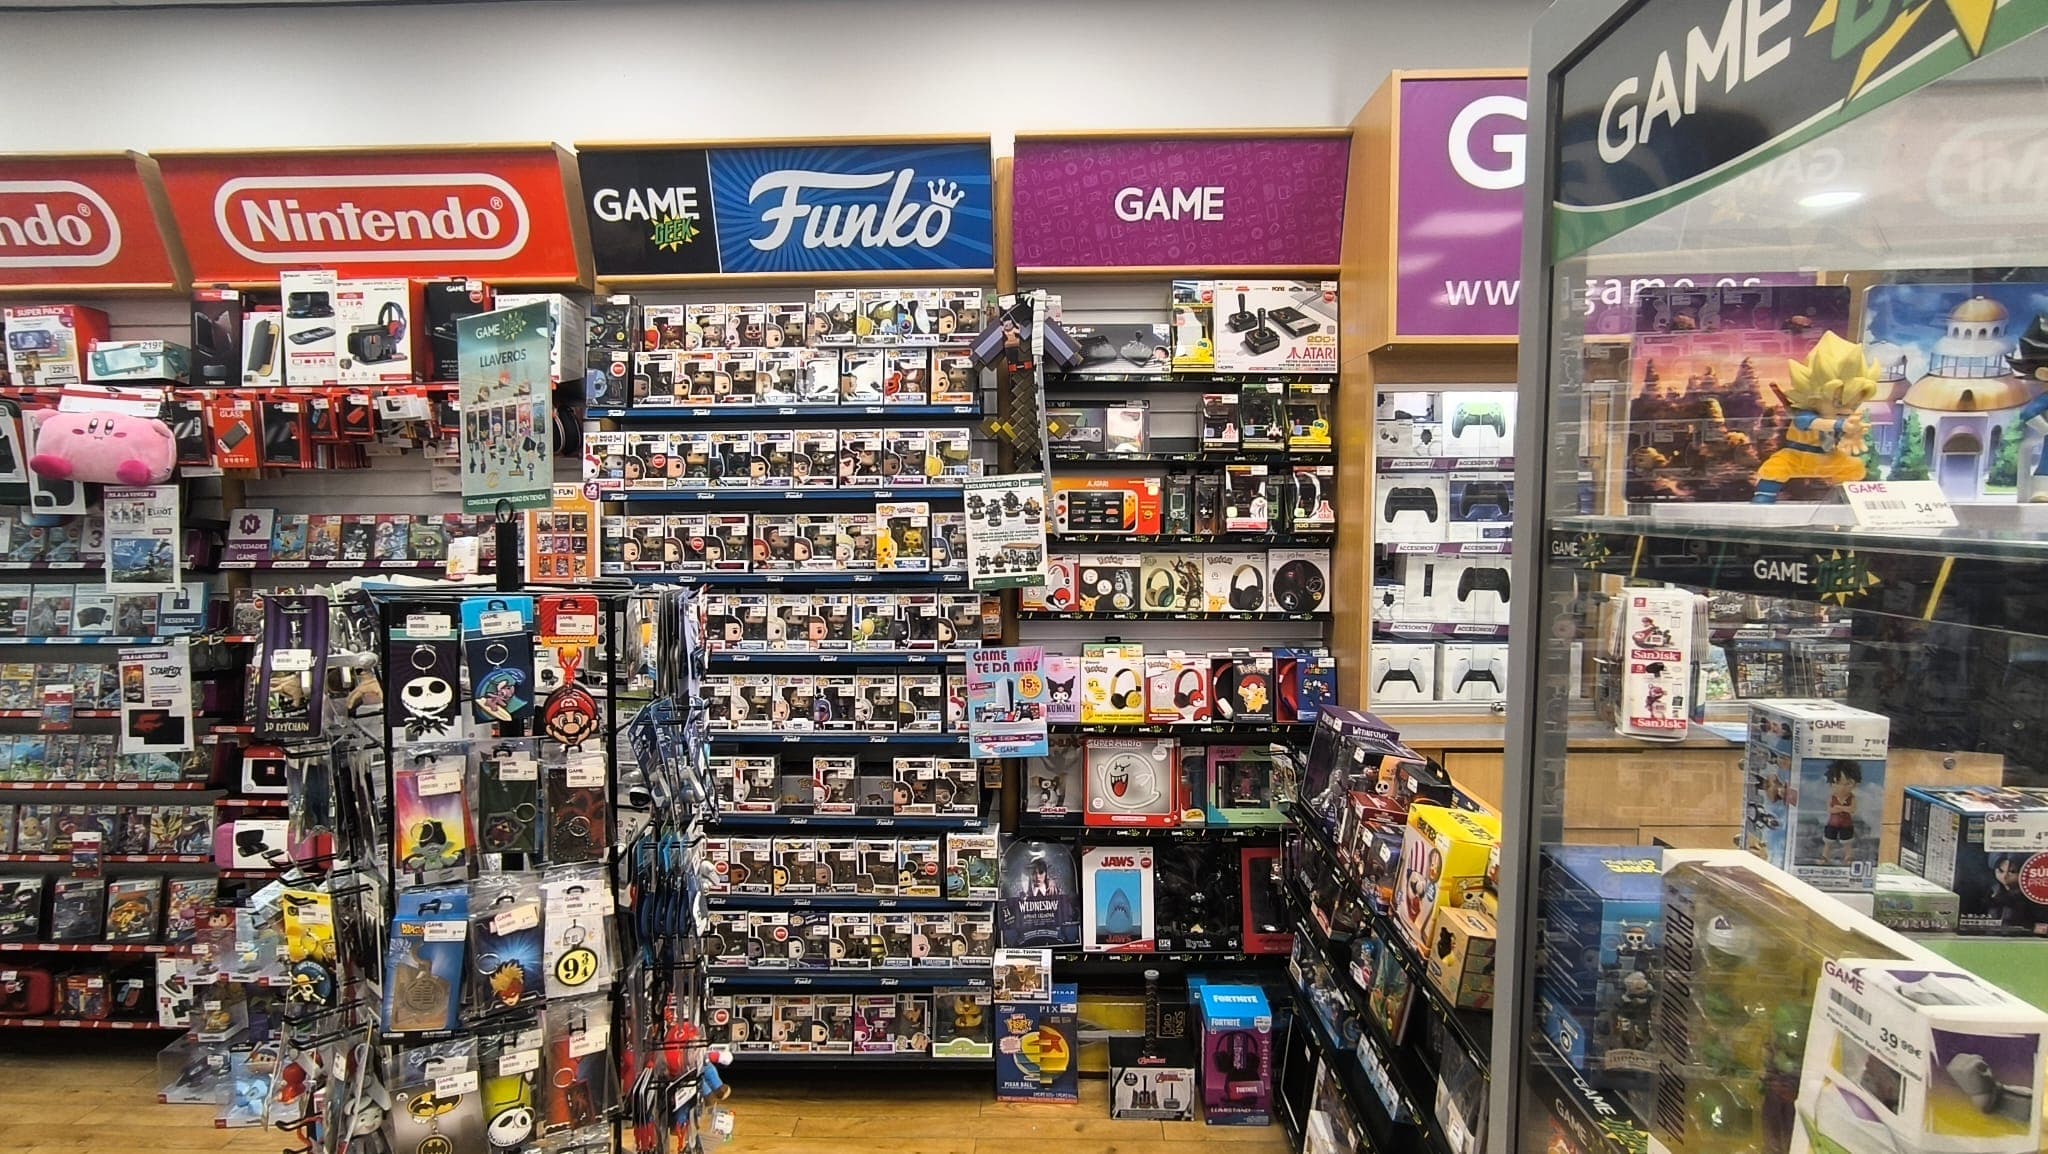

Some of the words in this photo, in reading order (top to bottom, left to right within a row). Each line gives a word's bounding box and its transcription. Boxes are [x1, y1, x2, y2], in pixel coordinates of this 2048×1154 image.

[1598, 0, 1791, 164] GAME
[594, 187, 699, 223] GAME
[749, 168, 952, 251] Funko
[1114, 187, 1225, 222] GAME
[241, 197, 500, 242] Nintendo
[654, 216, 692, 244] GEEK
[475, 323, 500, 340] GAME
[479, 348, 527, 368] LLAVEROS
[1303, 347, 1336, 359] ATARI
[558, 488, 574, 497] FUN
[1848, 483, 1887, 493] GAME
[1552, 540, 1578, 556] GAME
[1753, 561, 1808, 584] GAME
[973, 650, 1007, 661] GAME
[1633, 649, 1681, 661] SanDisk
[974, 663, 988, 673] TE
[993, 662, 1010, 673] DA
[1636, 717, 1686, 729] SanDisk
[1815, 720, 1846, 729] GAME
[1986, 813, 2018, 822] GAME
[1101, 856, 1135, 868] JAWS
[1850, 861, 1874, 877] 01
[1019, 900, 1059, 912] WEDNESDAY
[563, 958, 579, 980] 9
[1824, 960, 1865, 996] GAME
[1213, 994, 1258, 1004] FORTNITE
[1571, 1076, 1616, 1116] GAME
